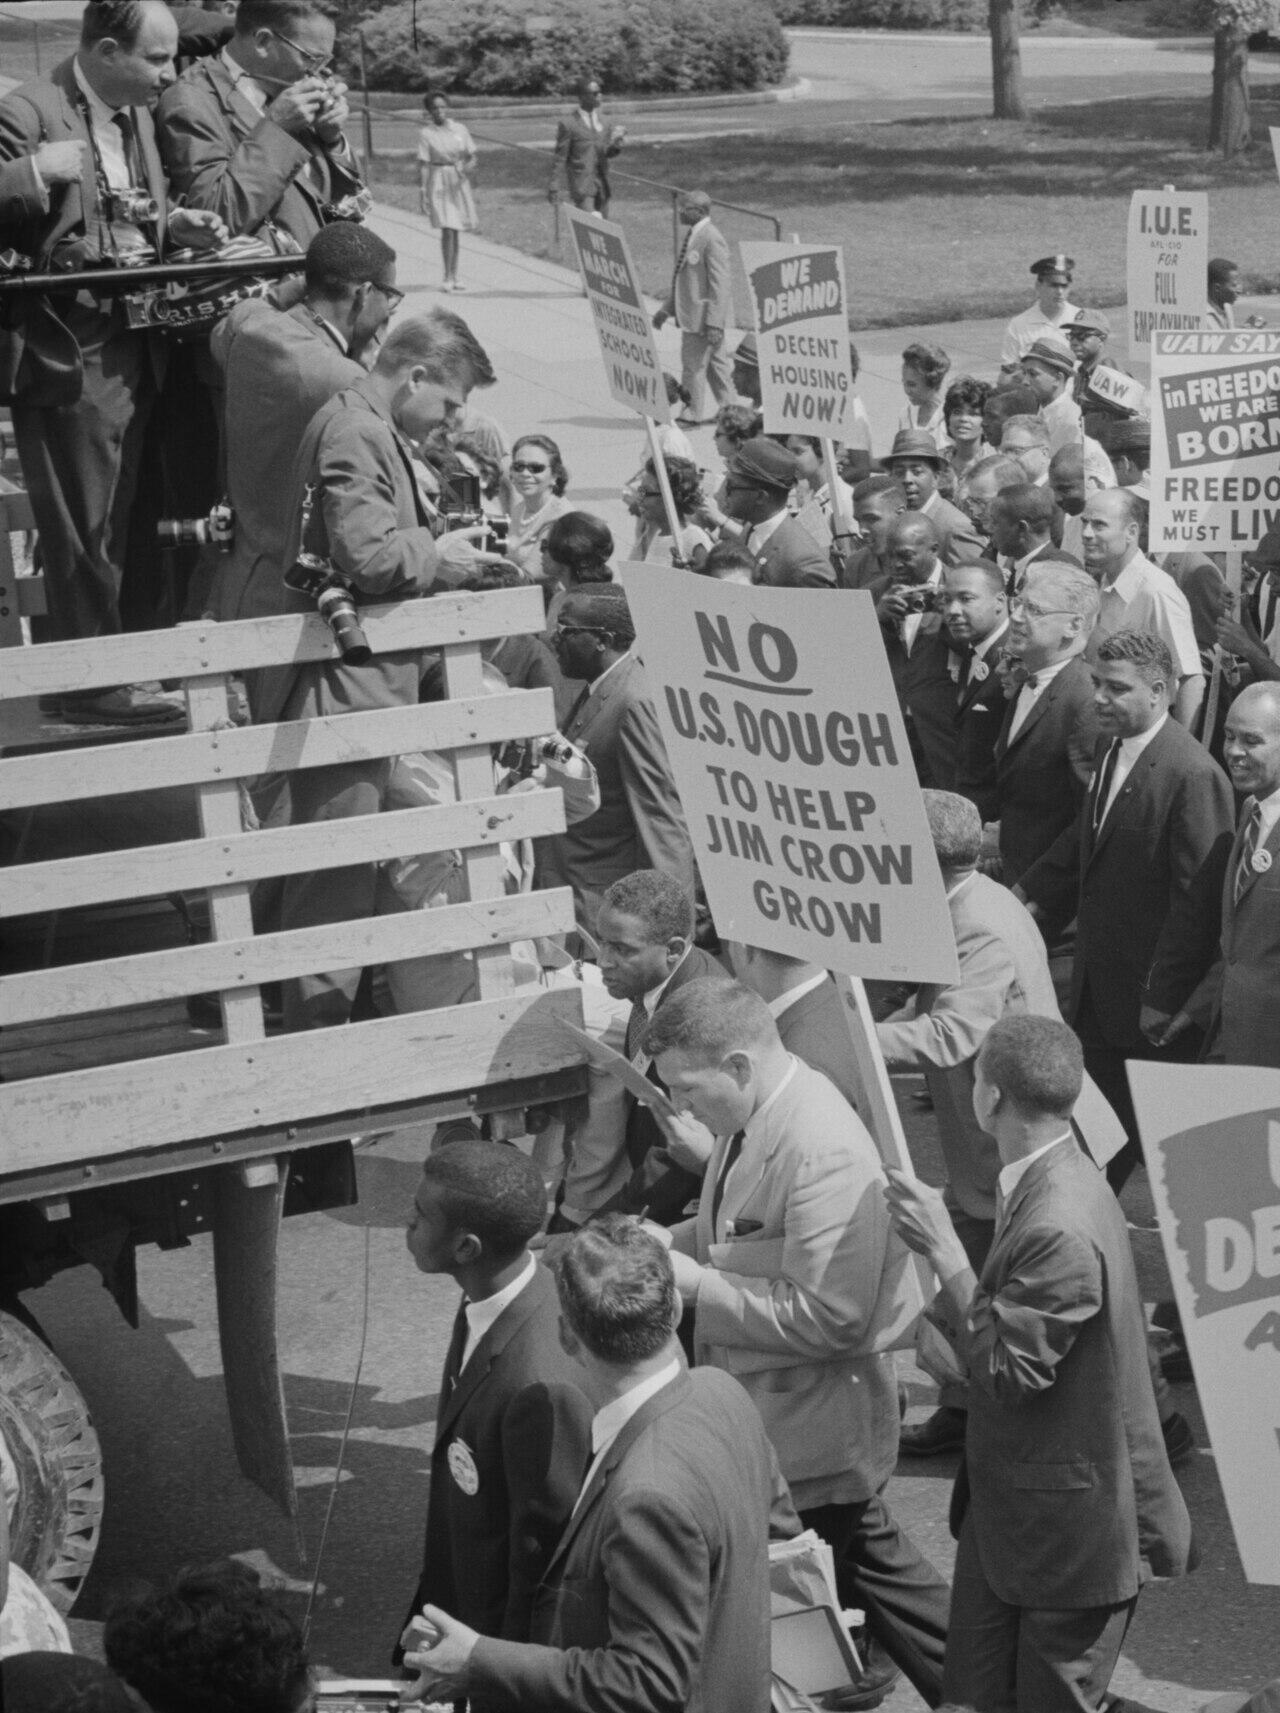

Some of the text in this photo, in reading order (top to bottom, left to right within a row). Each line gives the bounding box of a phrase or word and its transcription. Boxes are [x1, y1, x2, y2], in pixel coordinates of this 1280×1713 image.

[1140, 205, 1198, 237] I.U.E.
[582, 248, 631, 288] MARCH
[780, 257, 812, 290] WE
[1157, 252, 1179, 267] FOR
[601, 280, 622, 298] FOR
[763, 280, 839, 325] DEMAND
[1154, 271, 1177, 305] FULL
[591, 294, 648, 338] INTEGRATED
[600, 328, 655, 369] SCHOOLS
[774, 334, 839, 360] DECENT
[1161, 333, 1226, 353] UAW
[612, 364, 657, 405] NOW!
[770, 365, 848, 393] HOUSING
[1093, 371, 1130, 399] UAW
[782, 392, 847, 424] NOW!
[1163, 382, 1187, 409] in
[1199, 395, 1279, 423] WE ARE
[1171, 509, 1198, 523] WE
[1162, 525, 1221, 541] MUST
[694, 610, 798, 684] NO
[733, 699, 899, 768] DOUGH
[705, 764, 877, 832] TO HELP
[705, 814, 913, 886] JIM CROW
[752, 879, 882, 944] GROW
